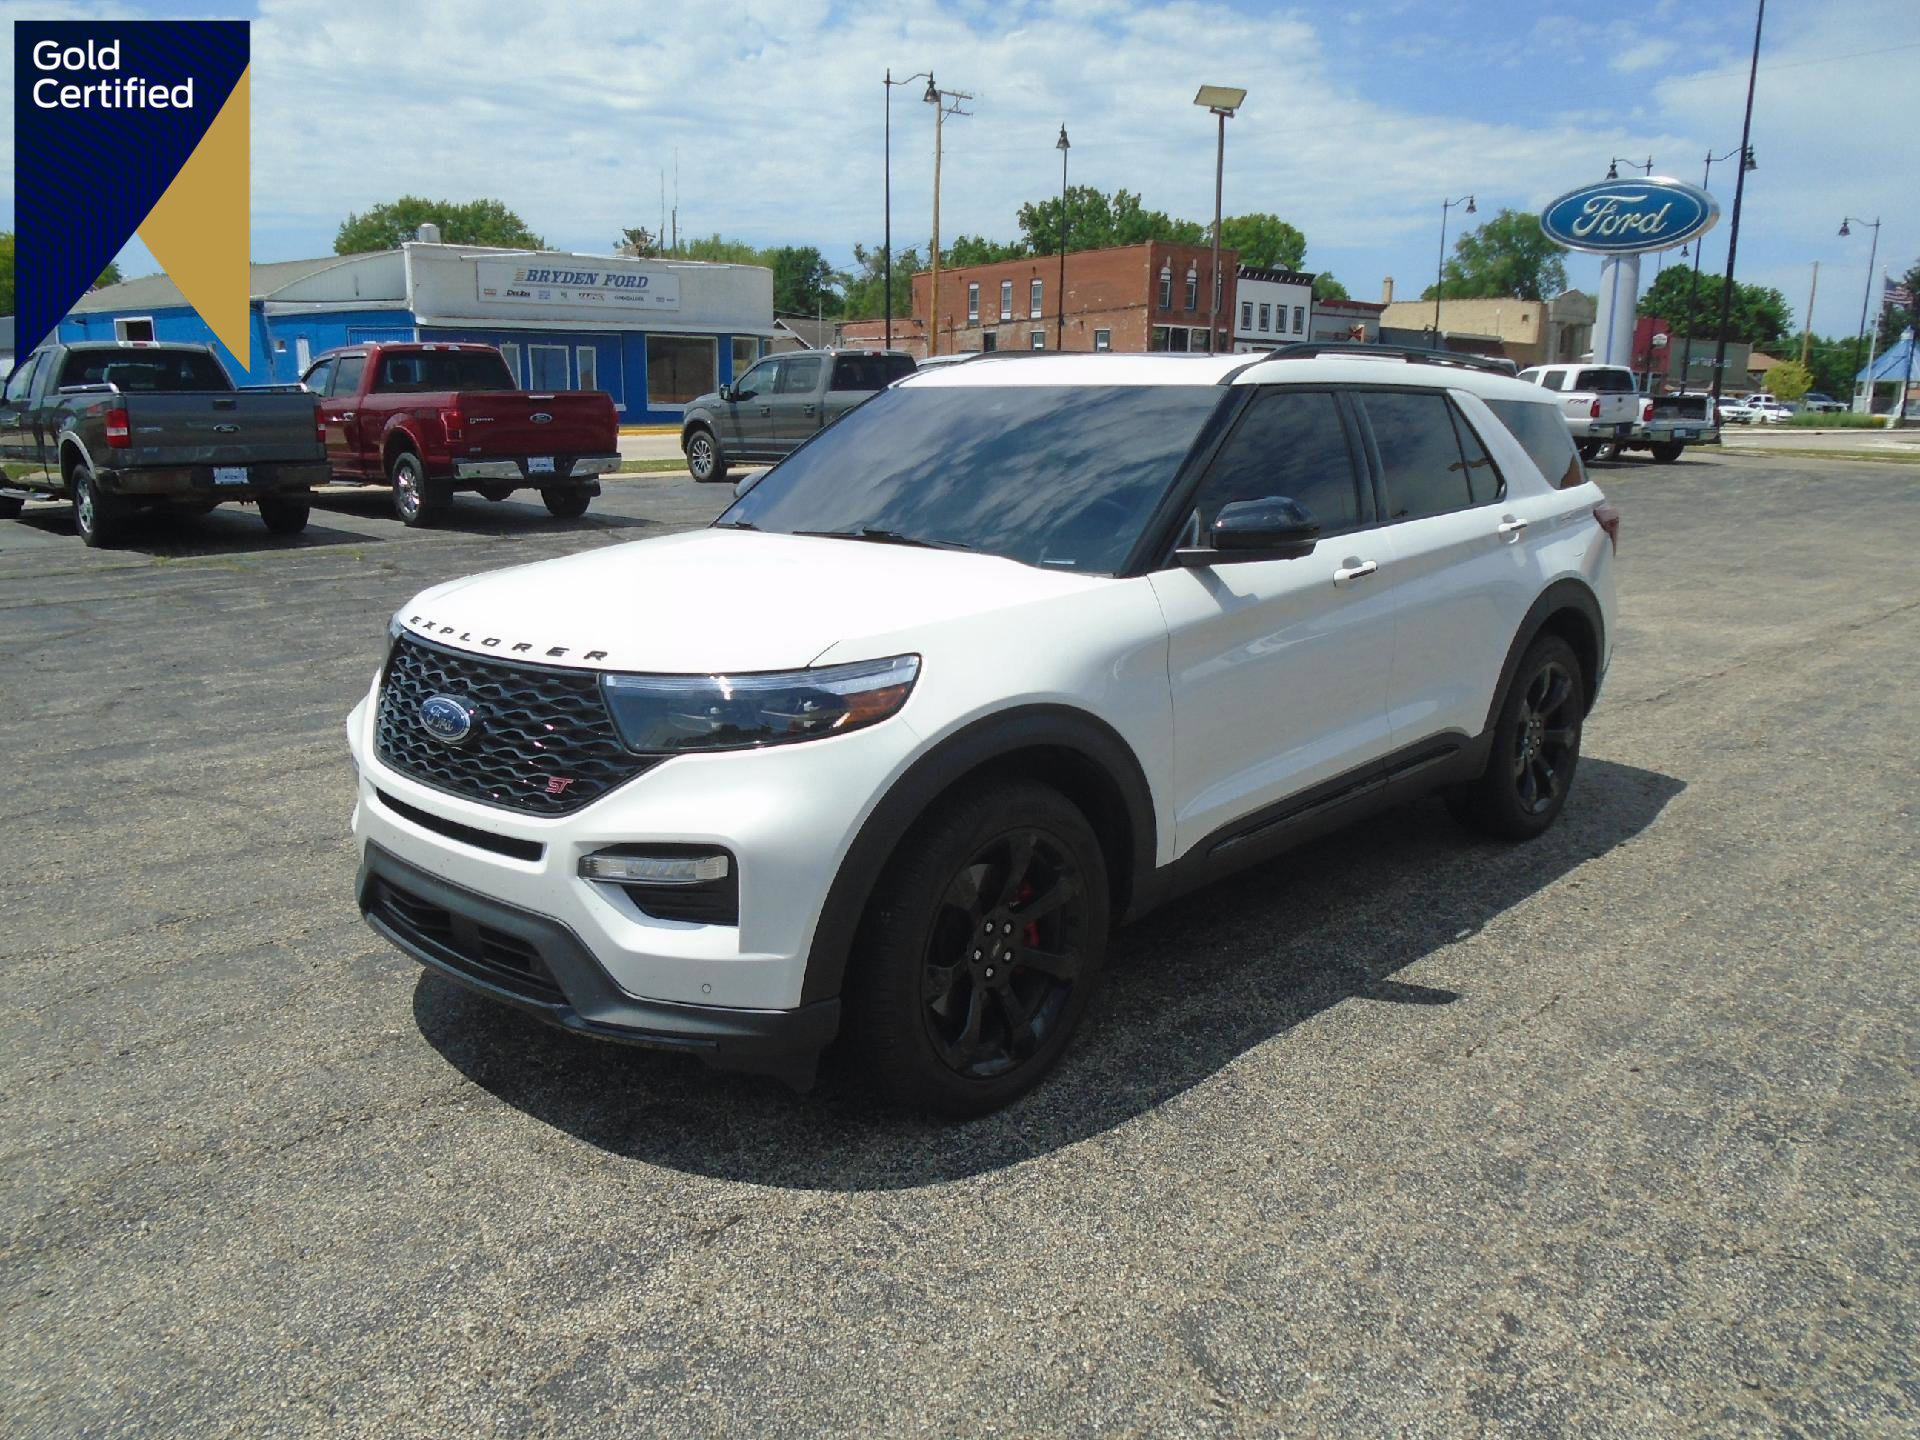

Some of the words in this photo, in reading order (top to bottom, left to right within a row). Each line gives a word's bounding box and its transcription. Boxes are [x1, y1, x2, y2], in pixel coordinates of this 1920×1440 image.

[1572, 194, 1673, 237] Ford
[525, 269, 599, 285] BRYDEN
[602, 274, 649, 289] FORD
[409, 615, 608, 661] EXPLORER
[544, 776, 574, 794] ST
